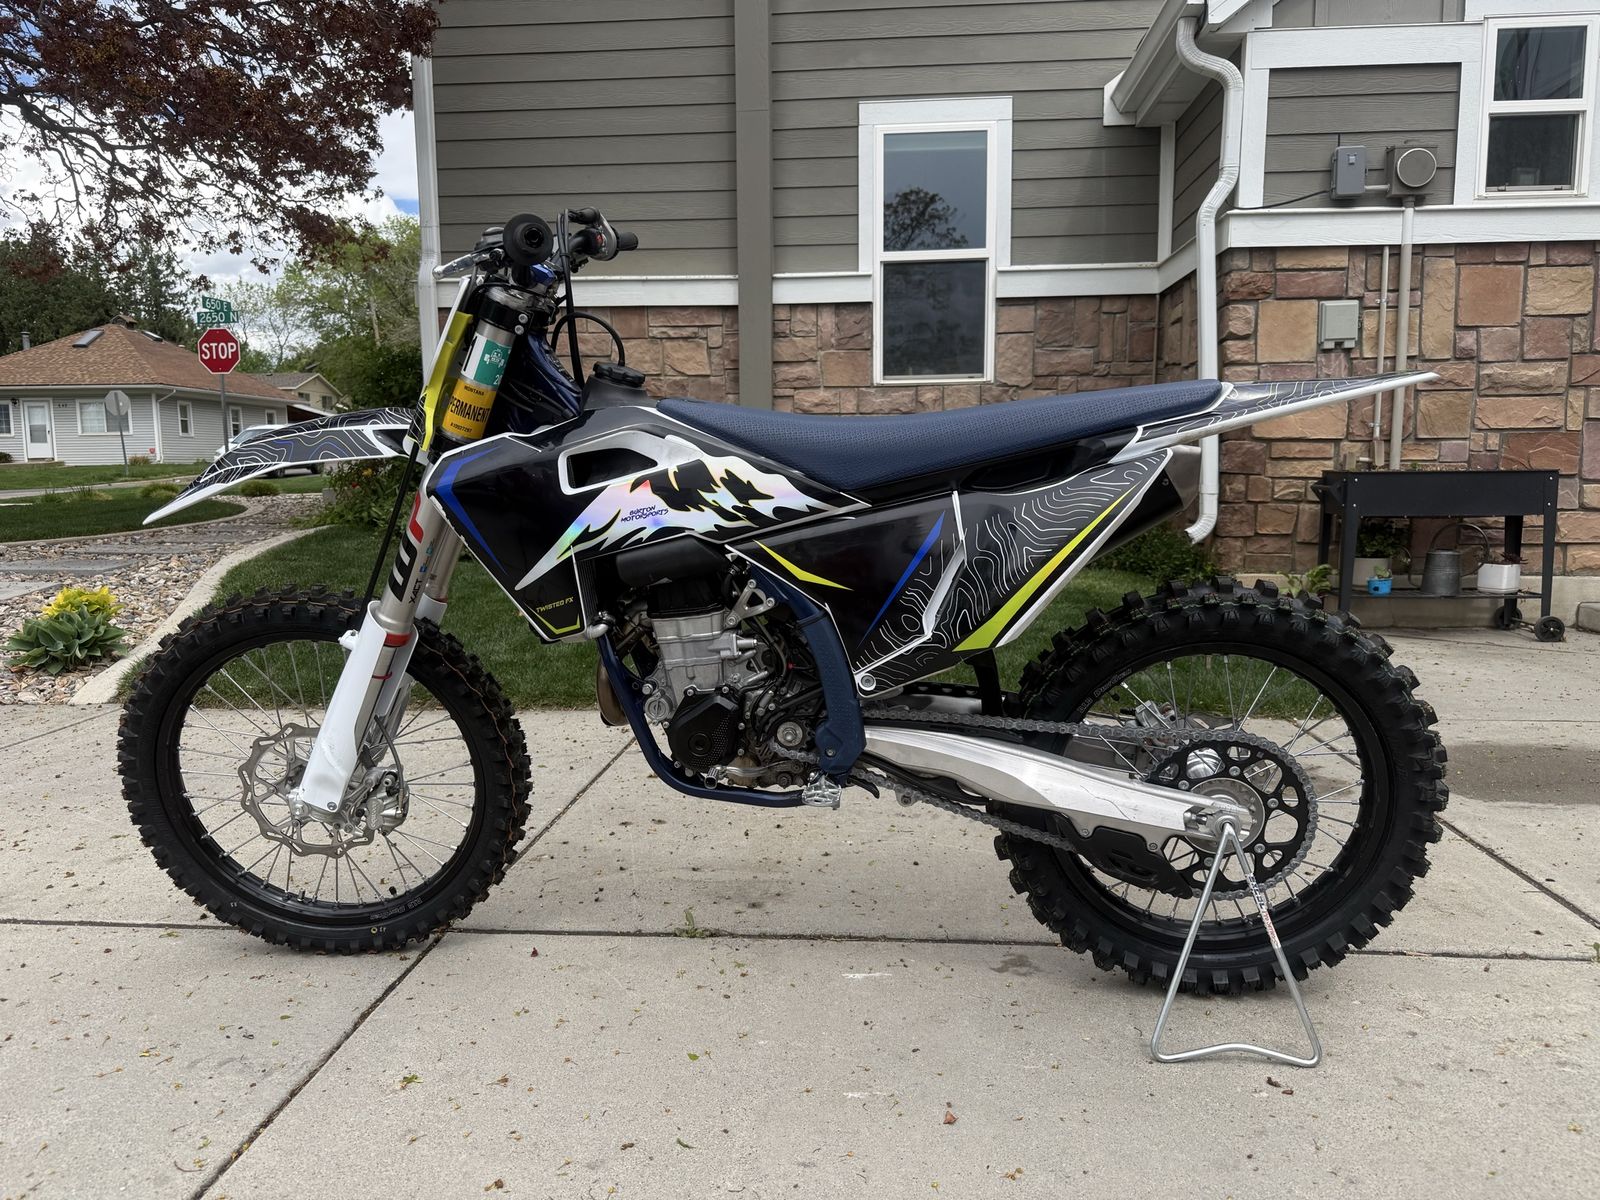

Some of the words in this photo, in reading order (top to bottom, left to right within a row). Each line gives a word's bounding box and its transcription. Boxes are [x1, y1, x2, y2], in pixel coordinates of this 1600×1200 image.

[205, 298, 221, 310] 650
[223, 301, 228, 312] E
[199, 311, 226, 323] 2650
[230, 311, 238, 322] N
[201, 342, 237, 360] STOP
[620, 508, 669, 522] MOTORSPORTS
[408, 578, 423, 604] XACT
[536, 599, 565, 613] TWISTED
[565, 596, 574, 605] FX
